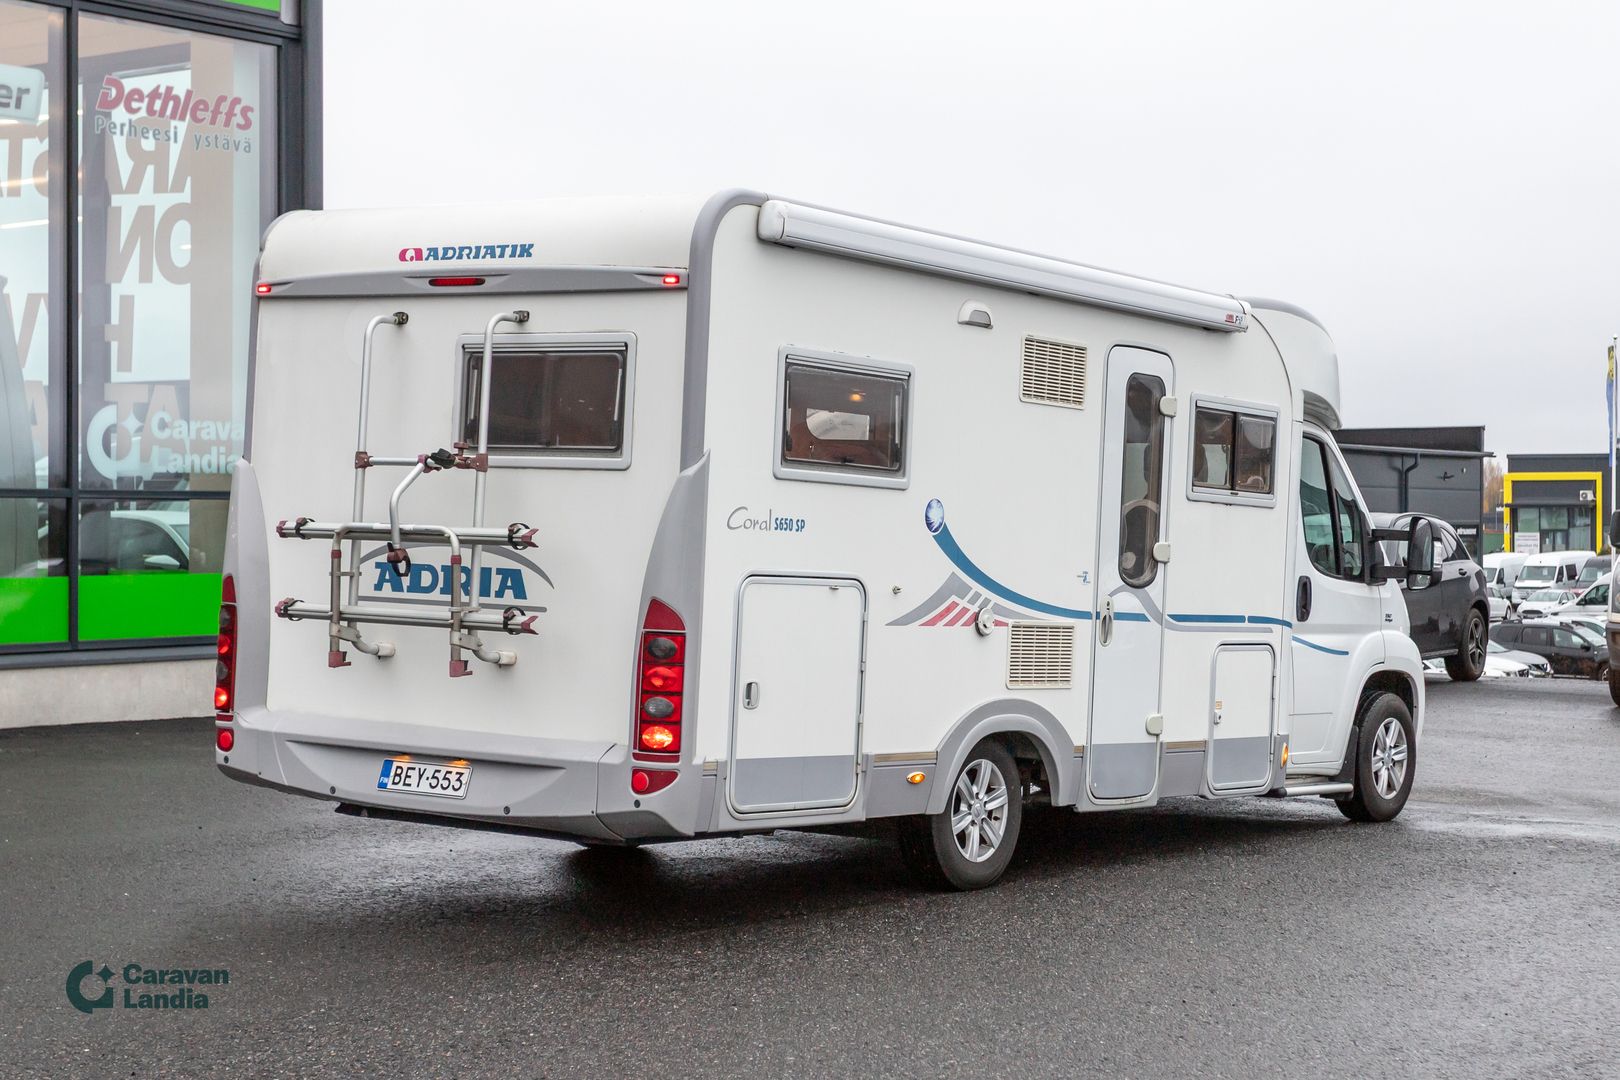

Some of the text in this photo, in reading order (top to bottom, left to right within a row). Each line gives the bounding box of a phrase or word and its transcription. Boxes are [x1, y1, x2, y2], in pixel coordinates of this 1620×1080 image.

[96, 75, 255, 131] Dethleffs
[95, 116, 252, 154] Perheesi ystävä
[425, 243, 534, 261] ADRIATIK
[151, 410, 244, 440] Carava
[151, 445, 241, 474] Landia
[726, 506, 806, 532] Coral S650 SP
[373, 561, 528, 600] ADRIA
[391, 765, 465, 792] BEY-553
